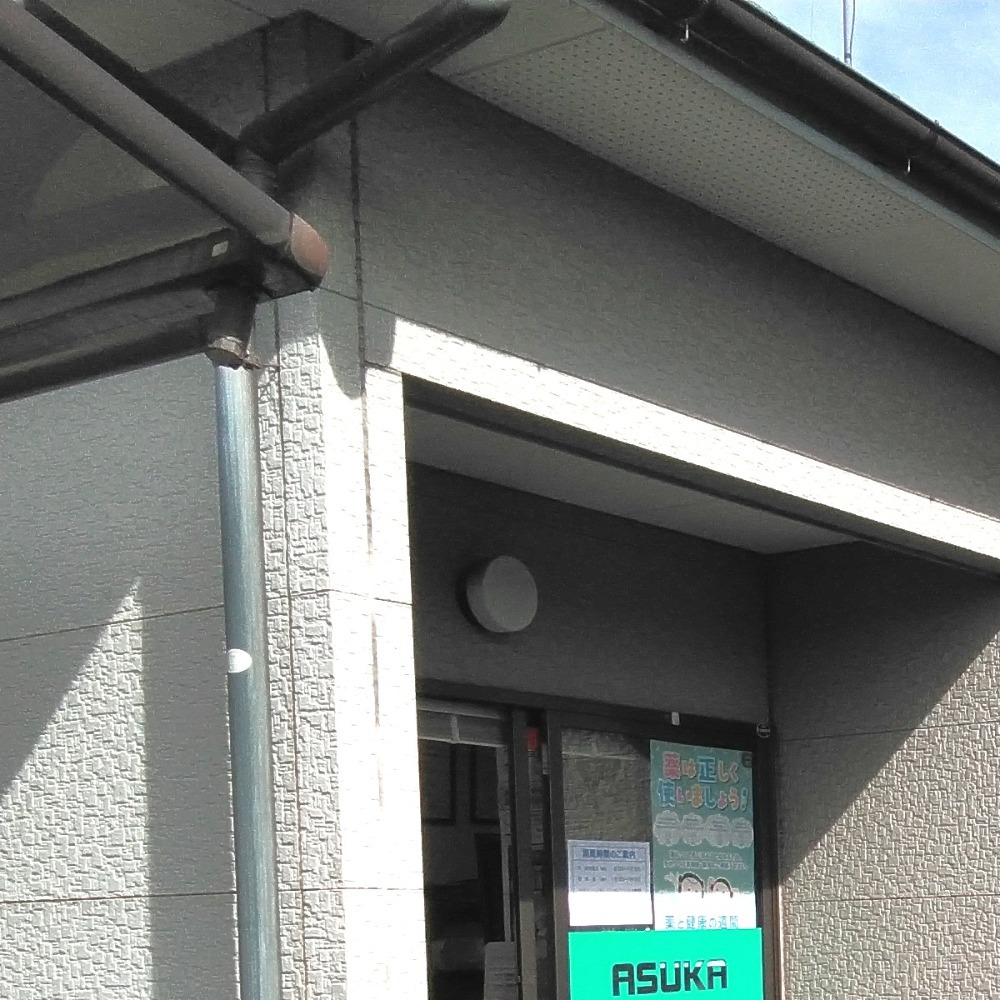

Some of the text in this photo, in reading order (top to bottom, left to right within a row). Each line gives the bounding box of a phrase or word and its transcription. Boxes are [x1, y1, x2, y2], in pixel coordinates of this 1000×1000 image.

[662, 751, 739, 783] 薬は正しく
[611, 959, 728, 997] ASUKA
